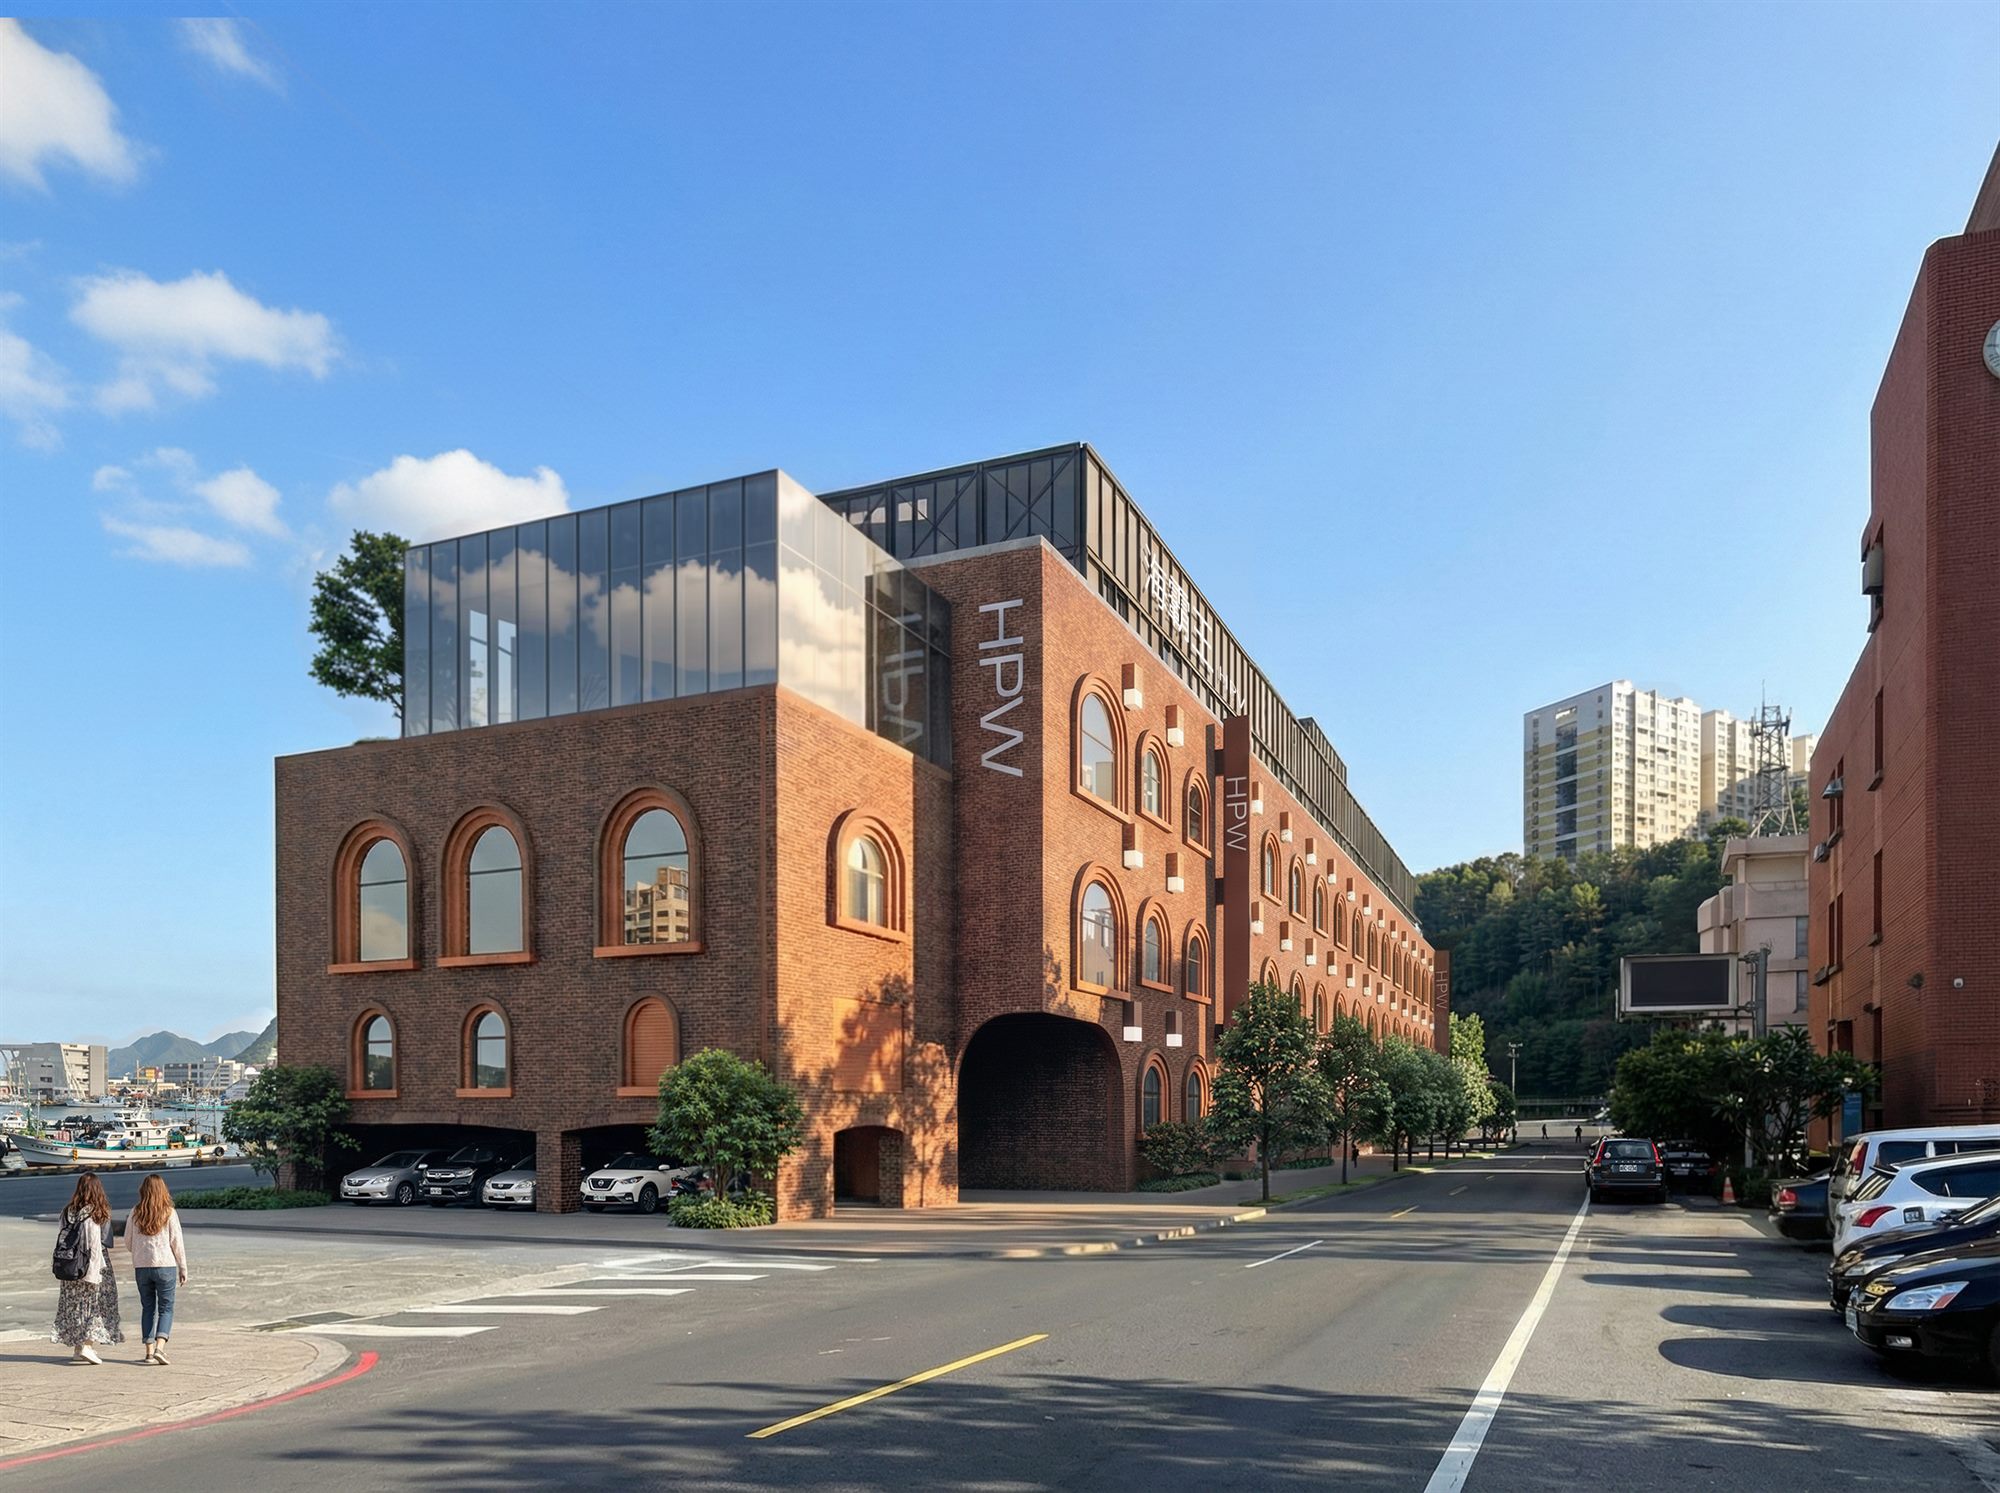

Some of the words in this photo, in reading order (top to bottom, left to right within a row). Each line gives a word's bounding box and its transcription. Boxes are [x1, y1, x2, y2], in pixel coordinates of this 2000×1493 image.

[1144, 543, 1214, 674] 海霸王
[979, 599, 1023, 777] HPW
[1226, 776, 1247, 851] HPW
[1435, 970, 1448, 1009] HPW
